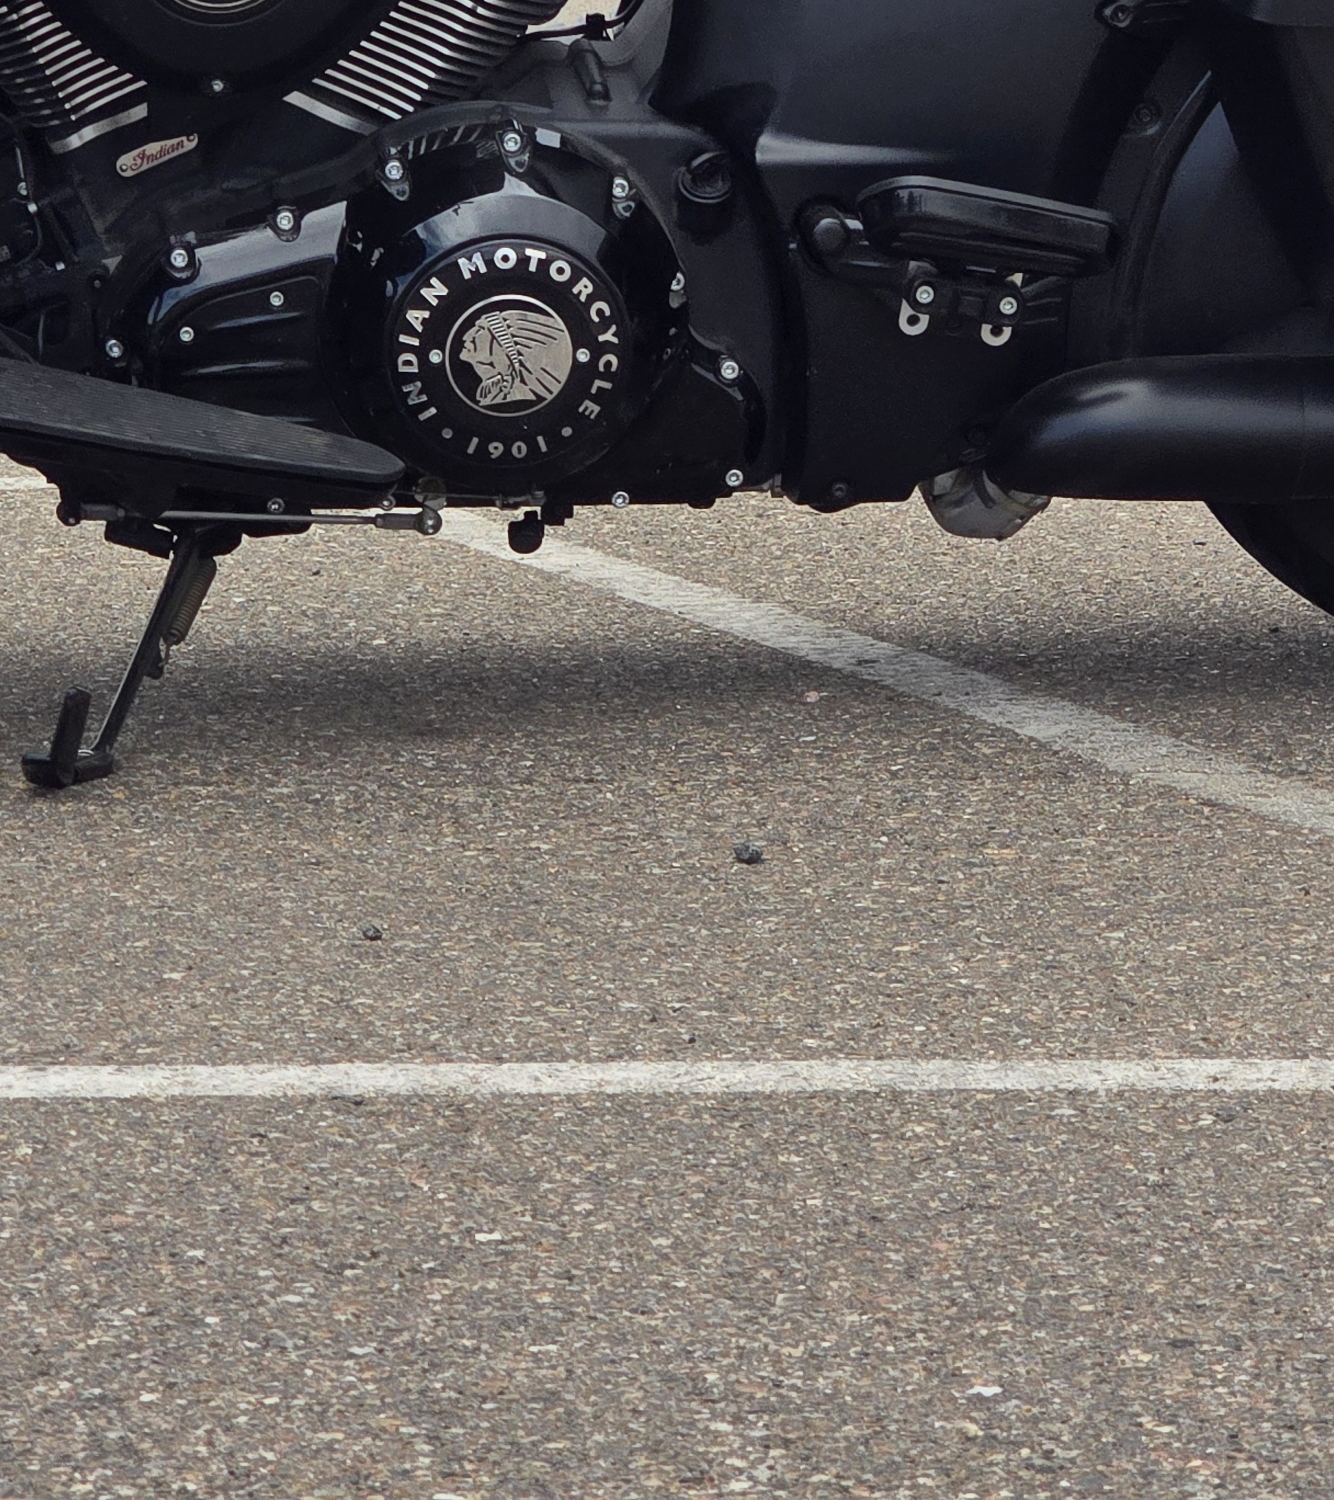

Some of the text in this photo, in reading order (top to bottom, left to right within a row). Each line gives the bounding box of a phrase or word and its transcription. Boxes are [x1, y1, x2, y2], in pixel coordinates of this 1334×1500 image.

[129, 139, 186, 172] Indian
[397, 247, 619, 422] INDIAN MOTORCYCLE
[467, 435, 548, 459] 1901
